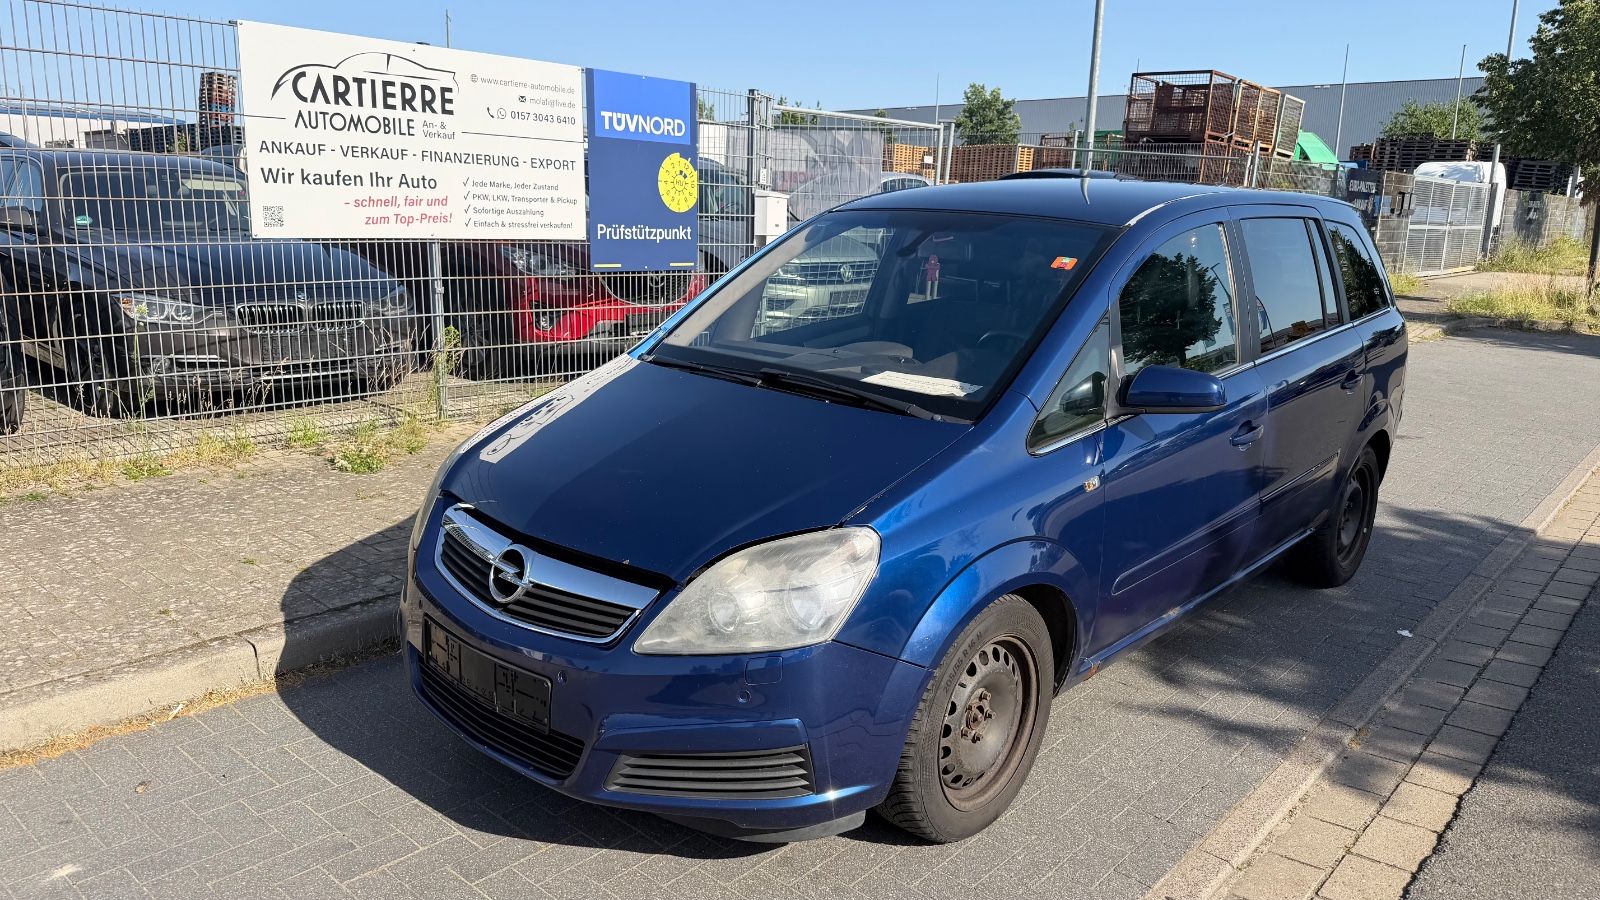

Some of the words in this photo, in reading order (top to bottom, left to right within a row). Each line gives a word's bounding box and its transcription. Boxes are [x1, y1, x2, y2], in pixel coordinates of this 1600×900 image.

[480, 76, 575, 94] www.cartierre-automobile.de
[292, 71, 454, 115] CARTIERRE
[294, 110, 415, 136] AUTOMOBILE
[422, 120, 438, 129] An-
[510, 111, 530, 121] 0157
[533, 112, 554, 123] 3043
[557, 116, 576, 125] 6410
[423, 130, 455, 140] Verkauf
[259, 141, 326, 156] ANKAUF
[340, 145, 408, 160] VERKAUF
[421, 151, 519, 168] FINANZIERUNG
[530, 158, 576, 171] EXPORT
[260, 167, 294, 184] Wir
[301, 168, 363, 187] kaufen
[370, 172, 393, 188] Ihr
[398, 174, 437, 190] Auto
[471, 180, 488, 188] Jede
[489, 181, 513, 190] Marke,
[353, 196, 400, 208] schnell,
[404, 196, 423, 207] fair
[426, 196, 448, 207] und
[472, 193, 491, 202] PKW,
[492, 195, 510, 203] LKW,
[511, 195, 548, 204] Transporter
[556, 197, 578, 205] Pickup
[473, 207, 504, 216] Sofortige
[506, 208, 544, 217] Auszahlung
[365, 214, 389, 225] zum
[393, 213, 452, 226] Top-Preis!
[473, 220, 499, 228] Einfach
[508, 220, 539, 229] stressfrei
[597, 224, 692, 243] Prüfstützpunkt
